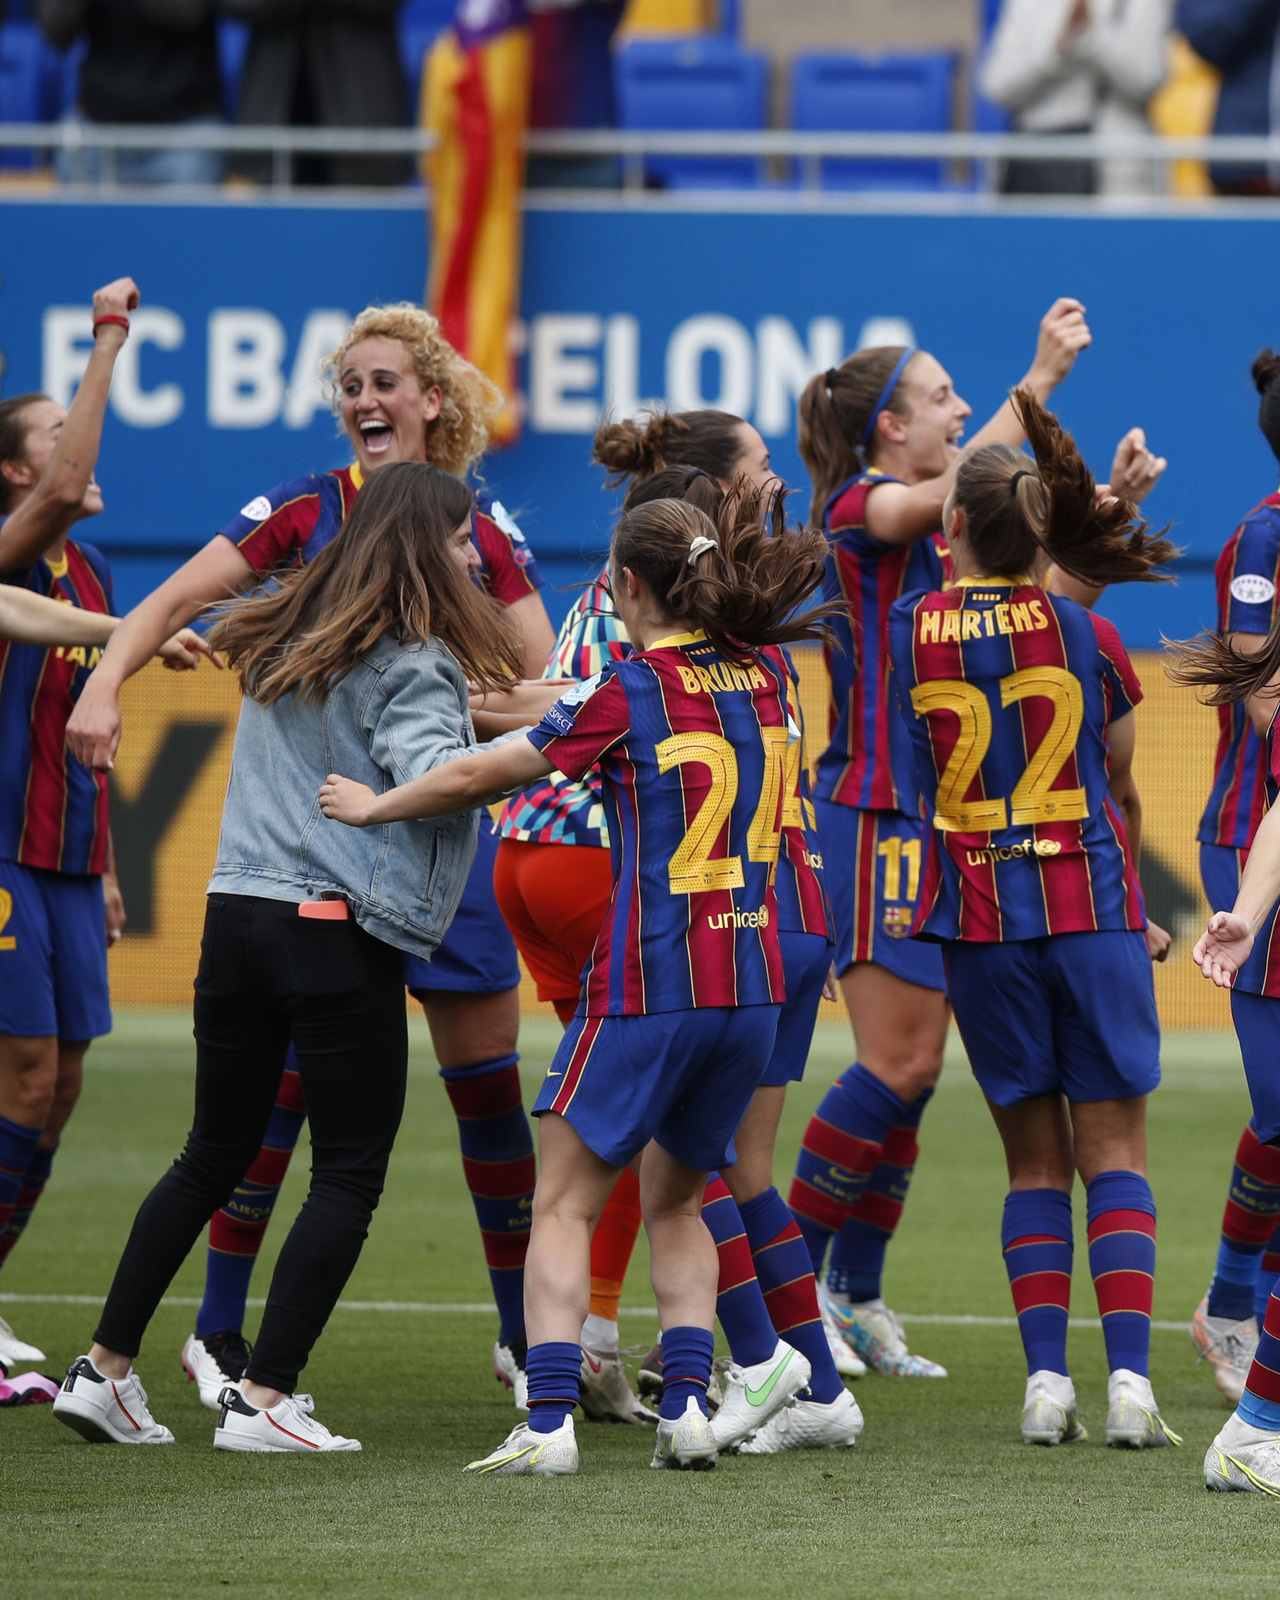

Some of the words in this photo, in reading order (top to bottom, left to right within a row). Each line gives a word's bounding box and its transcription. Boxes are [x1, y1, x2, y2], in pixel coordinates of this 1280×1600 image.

[42, 305, 185, 429] FC
[207, 306, 917, 437] BAELON
[920, 600, 1049, 644] MARTENS
[675, 661, 768, 694] BRUNA
[909, 665, 1090, 833] 22
[654, 726, 788, 895] 24
[877, 836, 922, 901] 11
[966, 838, 1032, 866] unicef
